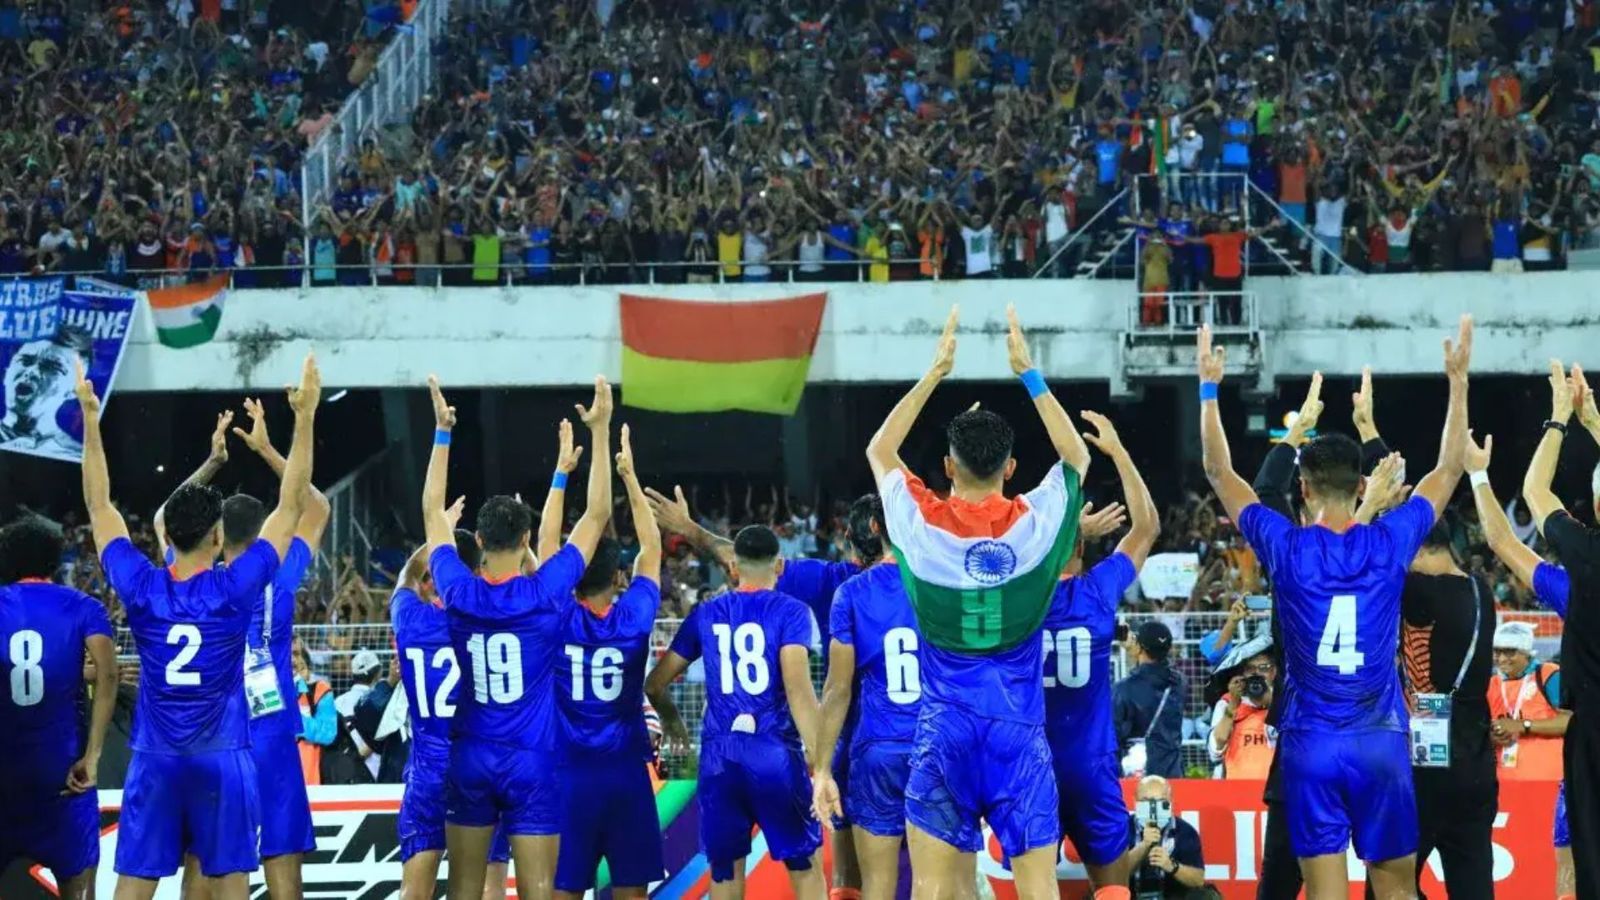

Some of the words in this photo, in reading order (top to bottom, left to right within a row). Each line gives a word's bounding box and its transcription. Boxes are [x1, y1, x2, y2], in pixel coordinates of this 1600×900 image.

[10, 630, 43, 706] 8
[166, 624, 201, 685] 2
[467, 633, 523, 704] 19
[712, 622, 769, 695] 18
[884, 626, 921, 704] 6
[1317, 595, 1364, 674] 4
[406, 647, 461, 718] 12
[565, 644, 624, 701] 16
